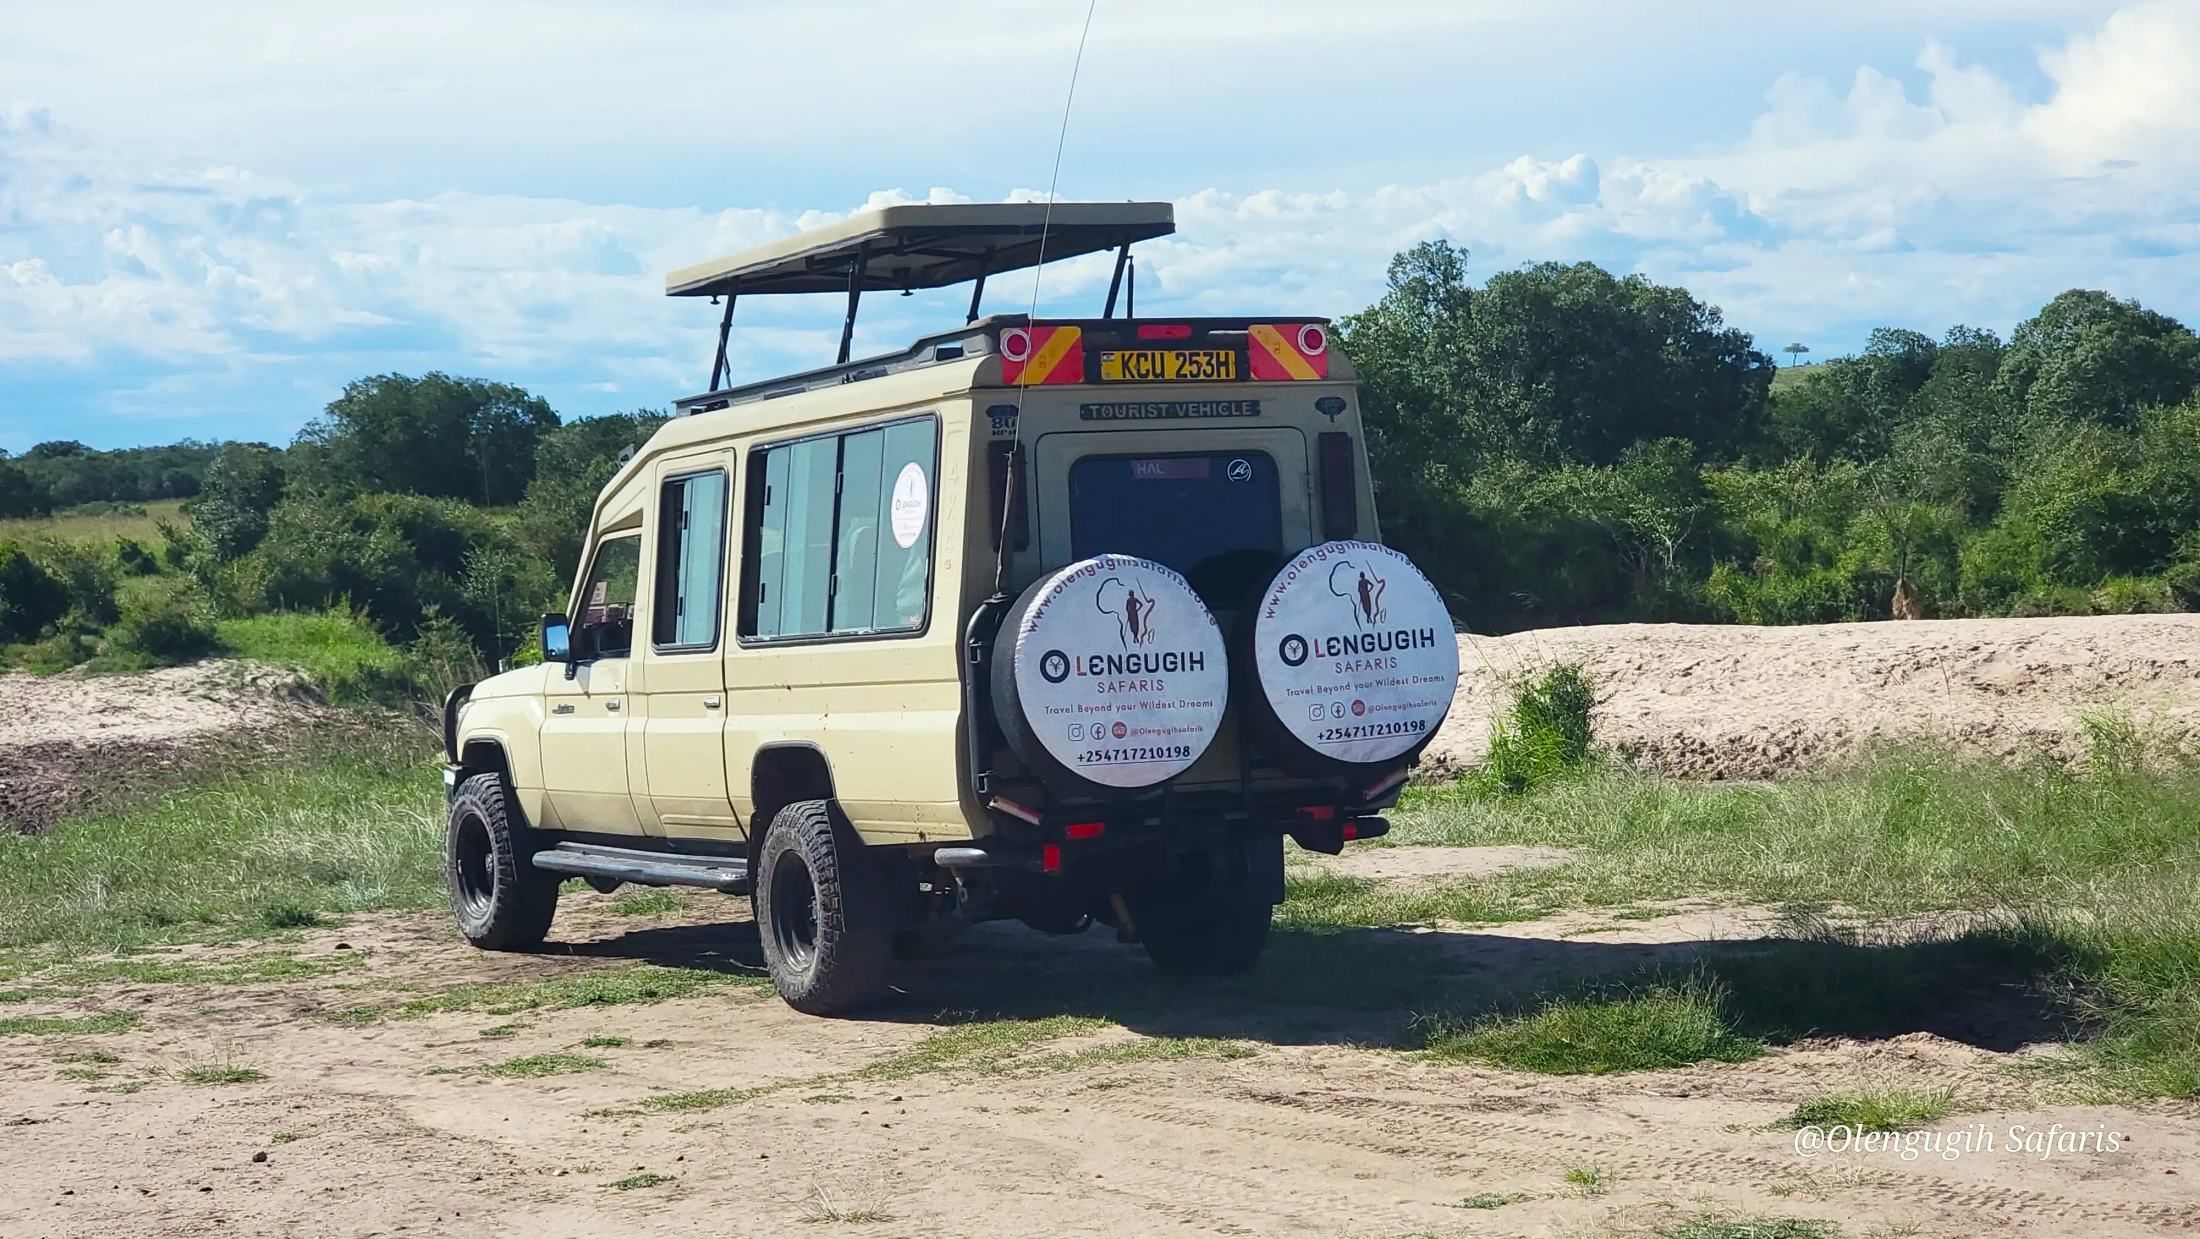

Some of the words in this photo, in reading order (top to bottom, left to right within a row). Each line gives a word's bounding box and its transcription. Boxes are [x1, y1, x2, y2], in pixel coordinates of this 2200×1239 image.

[1121, 352, 1166, 379] KCU
[1175, 351, 1230, 378] 253H
[1088, 403, 1169, 419] TOURIST
[1175, 401, 1253, 417] VEHICLE
[1278, 628, 1435, 667] OLENGUGIH
[1039, 649, 1205, 684] OLENGUGIH
[1335, 657, 1398, 674] SAFARIS
[1097, 679, 1165, 694] SAFARIS
[1286, 685, 1314, 697] Travel
[1316, 682, 1351, 695] Beyond
[1354, 682, 1373, 691] your
[1375, 677, 1409, 688] Wildest
[1412, 675, 1445, 684] Dreams
[1045, 704, 1074, 715] Travel
[1077, 702, 1112, 714] Beyond
[1116, 704, 1136, 714] your
[1139, 701, 1176, 710] Wildest
[1179, 699, 1214, 708] Dreams
[1317, 720, 1426, 741] +254717210198
[1076, 746, 1191, 763] +254717210198
